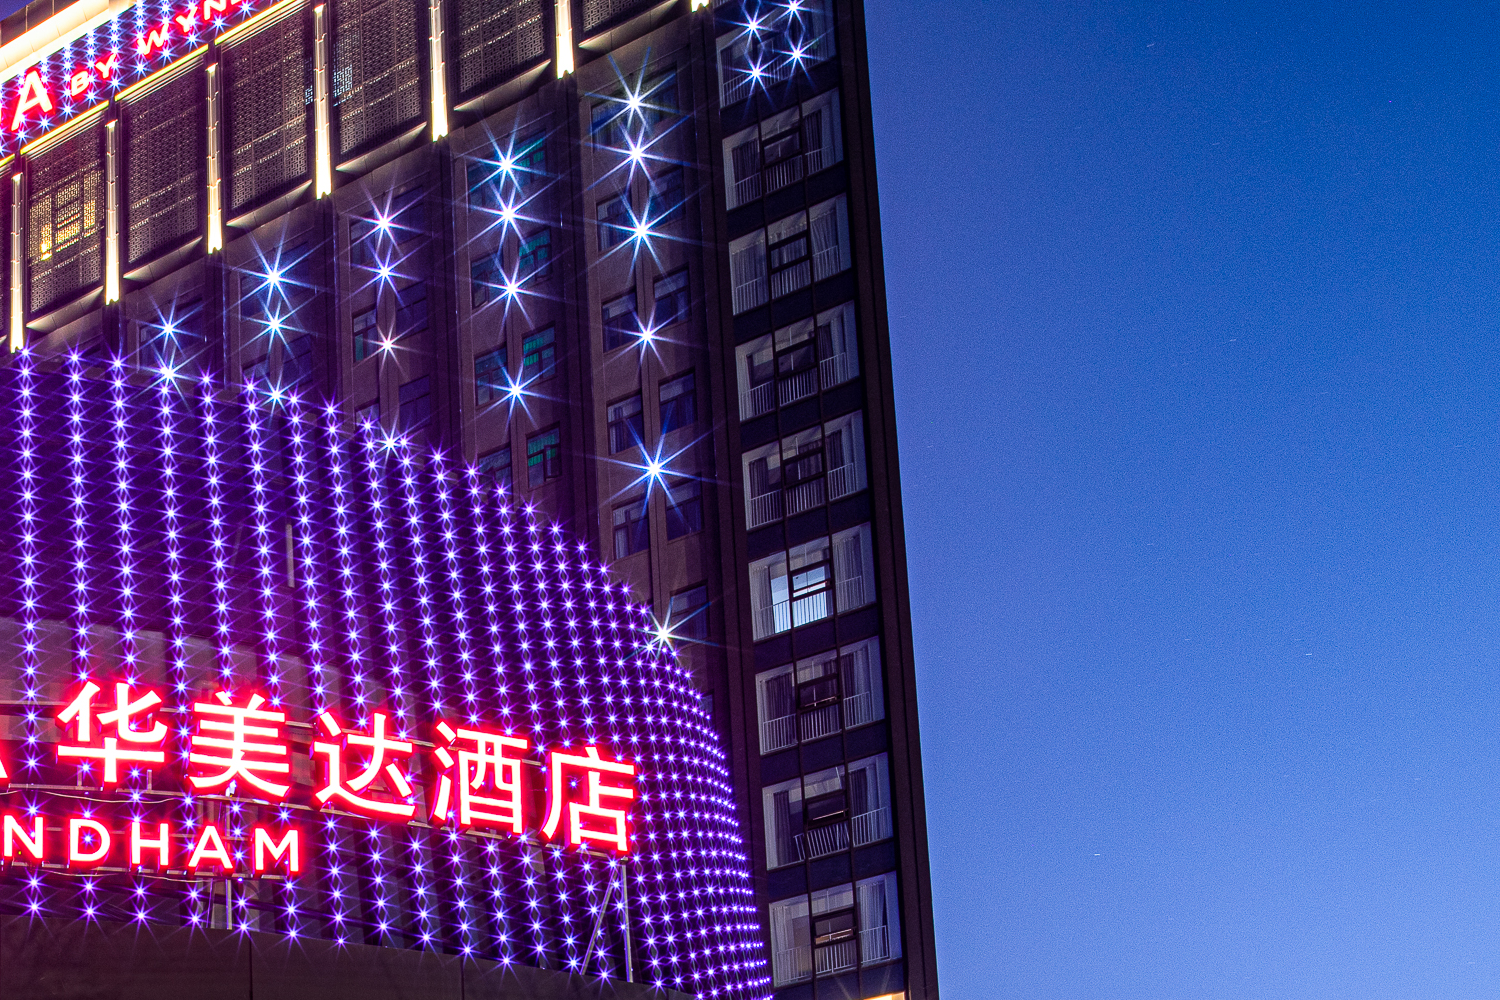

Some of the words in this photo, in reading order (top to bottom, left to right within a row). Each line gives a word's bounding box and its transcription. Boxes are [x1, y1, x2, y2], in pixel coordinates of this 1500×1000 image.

[70, 53, 117, 97] BY
[137, 0, 241, 56] WYN
[56, 681, 636, 854] 华美达酒店
